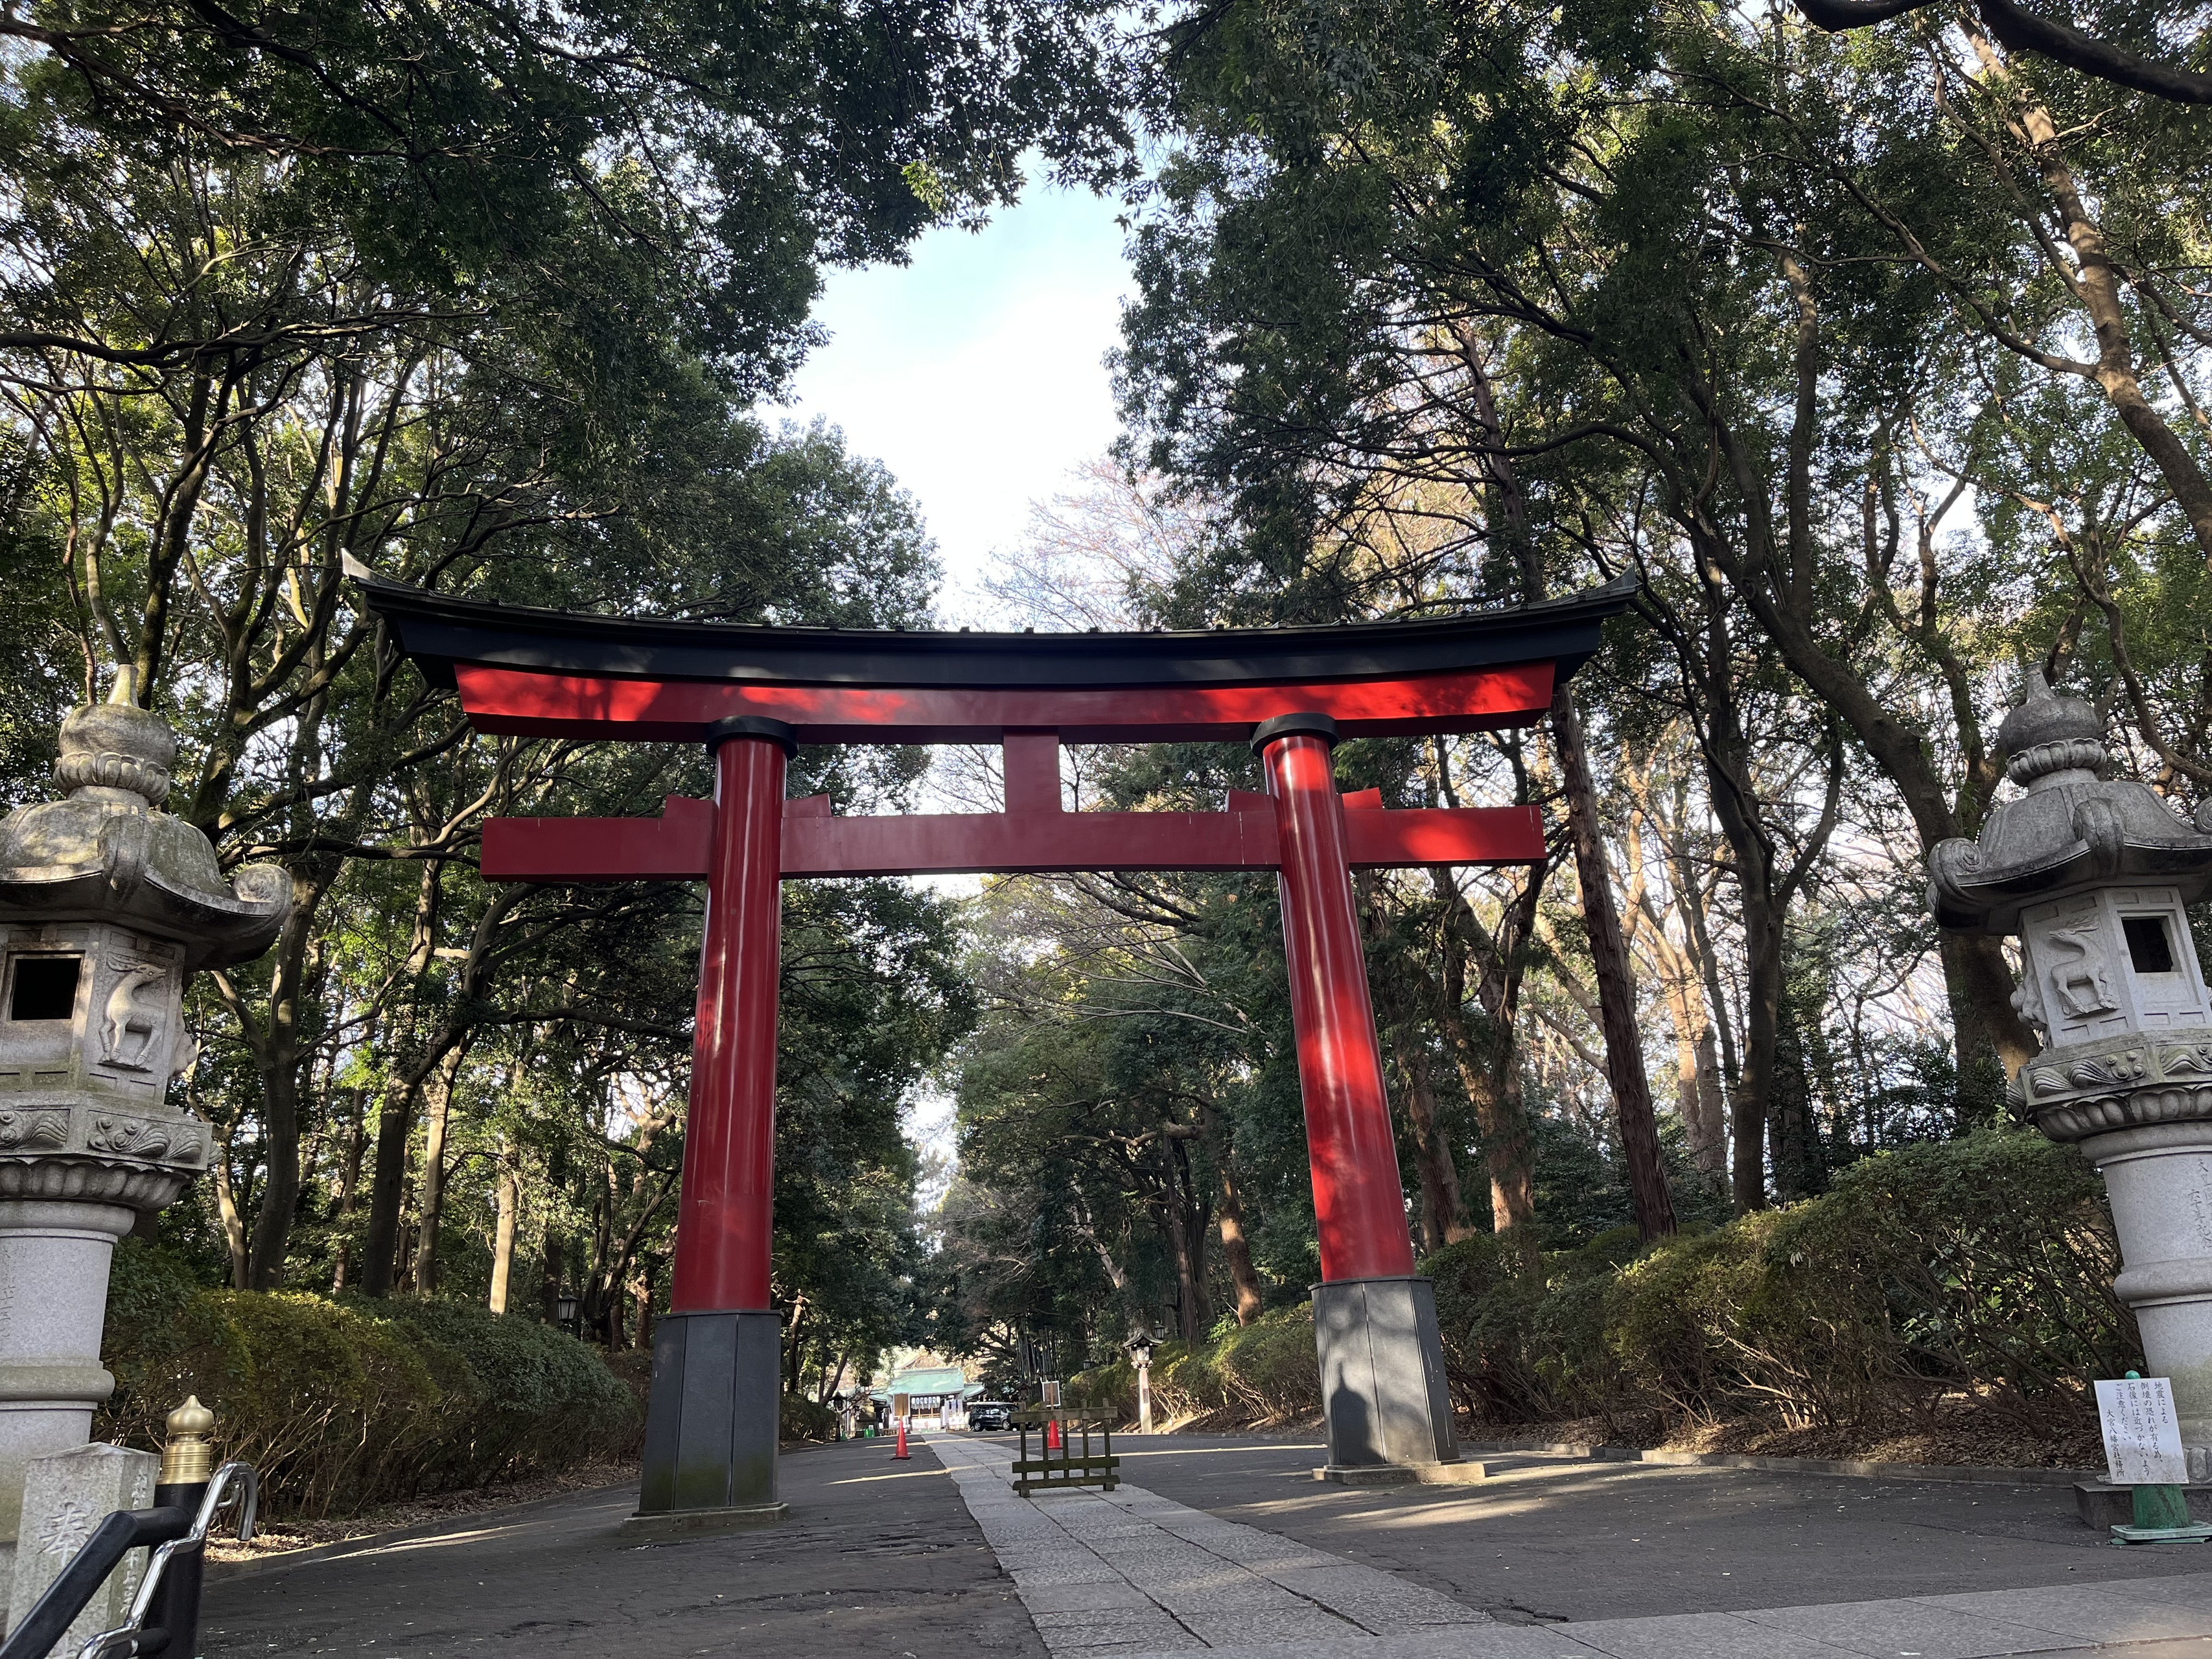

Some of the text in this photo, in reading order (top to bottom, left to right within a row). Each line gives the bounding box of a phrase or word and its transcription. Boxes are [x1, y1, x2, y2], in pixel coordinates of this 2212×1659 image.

[2115, 1383, 2132, 1441] ご注意ください
[2127, 1382, 2150, 1476] 石像には近づかないよう
[2154, 1382, 2169, 1424] 地震による
[2106, 1409, 2125, 1478] 大宮八幡宮社務所
